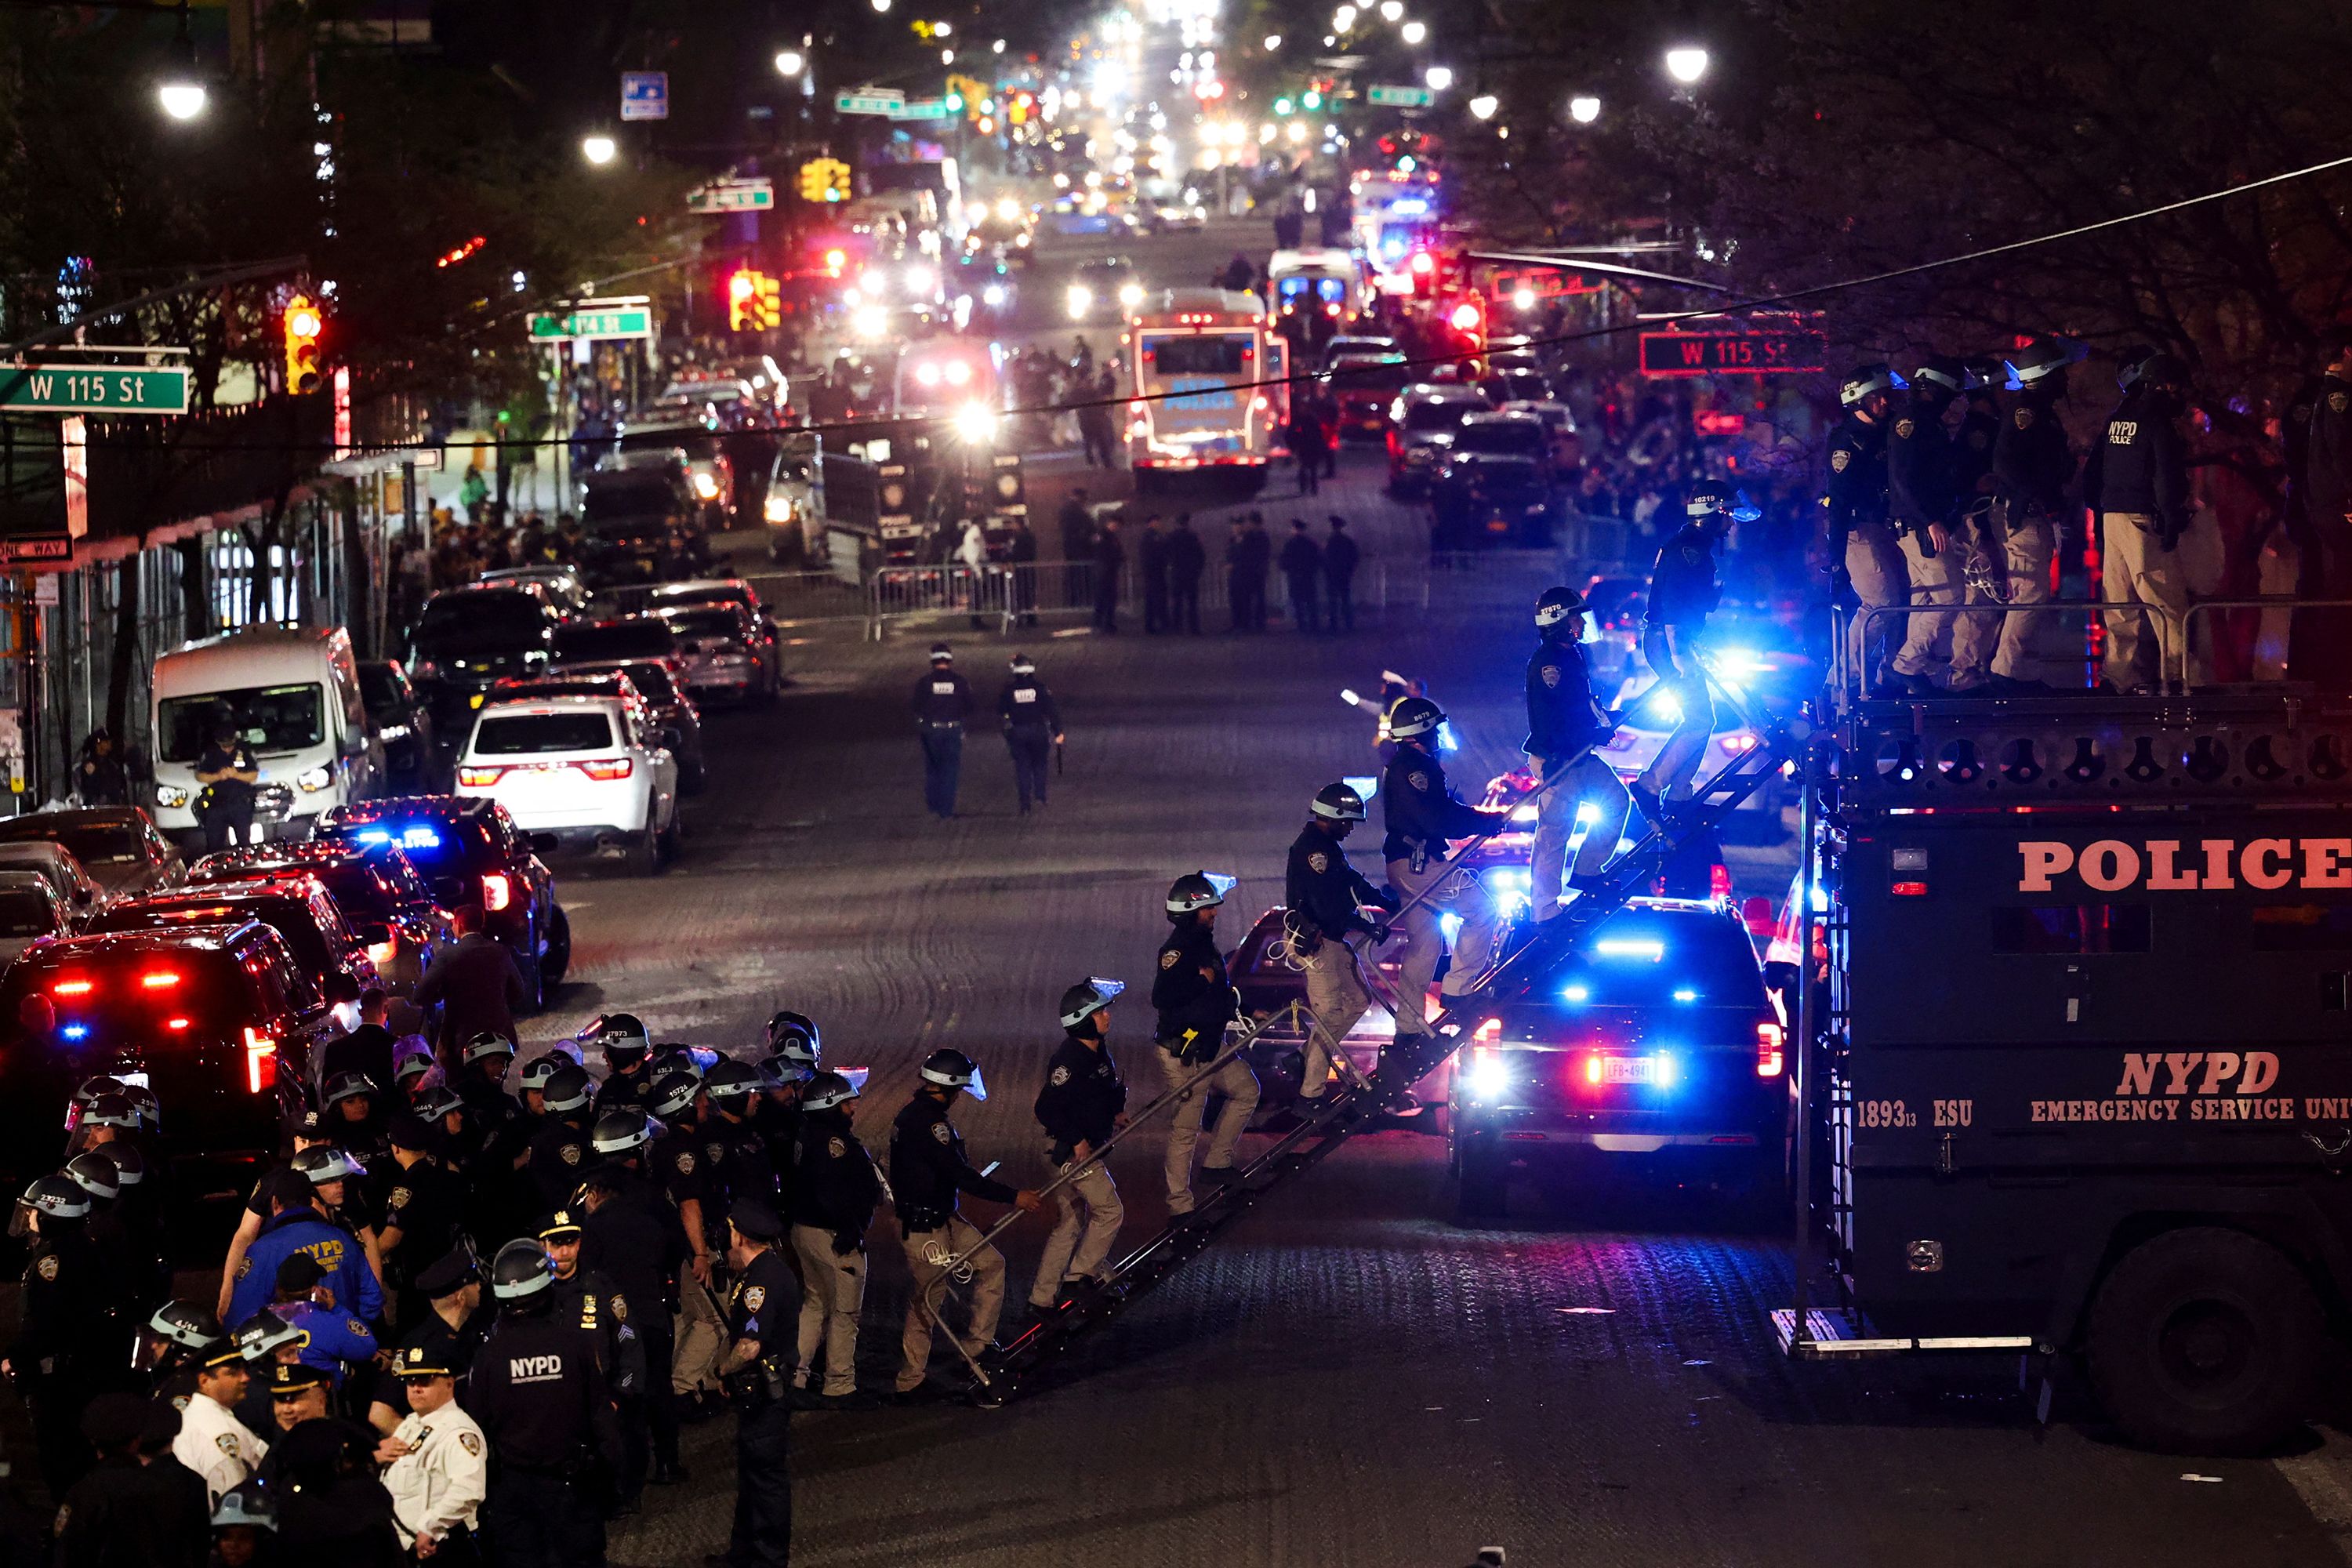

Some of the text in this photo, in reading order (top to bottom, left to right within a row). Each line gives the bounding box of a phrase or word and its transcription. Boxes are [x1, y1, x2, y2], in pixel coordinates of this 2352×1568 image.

[1681, 342, 1704, 365] W
[1717, 341, 1752, 364] 115
[30, 375, 144, 402] W 115 St
[2108, 421, 2137, 436] NYPD
[2109, 435, 2132, 445] POLICE
[1694, 495, 1715, 503] 10219
[2018, 838, 2352, 891] POLICE
[2116, 1051, 2280, 1095] NYPD
[1933, 1100, 1973, 1127] ESU
[2031, 1098, 2352, 1122] EMERGENCY SERVICE UNI
[510, 1354, 562, 1378] NYPD
